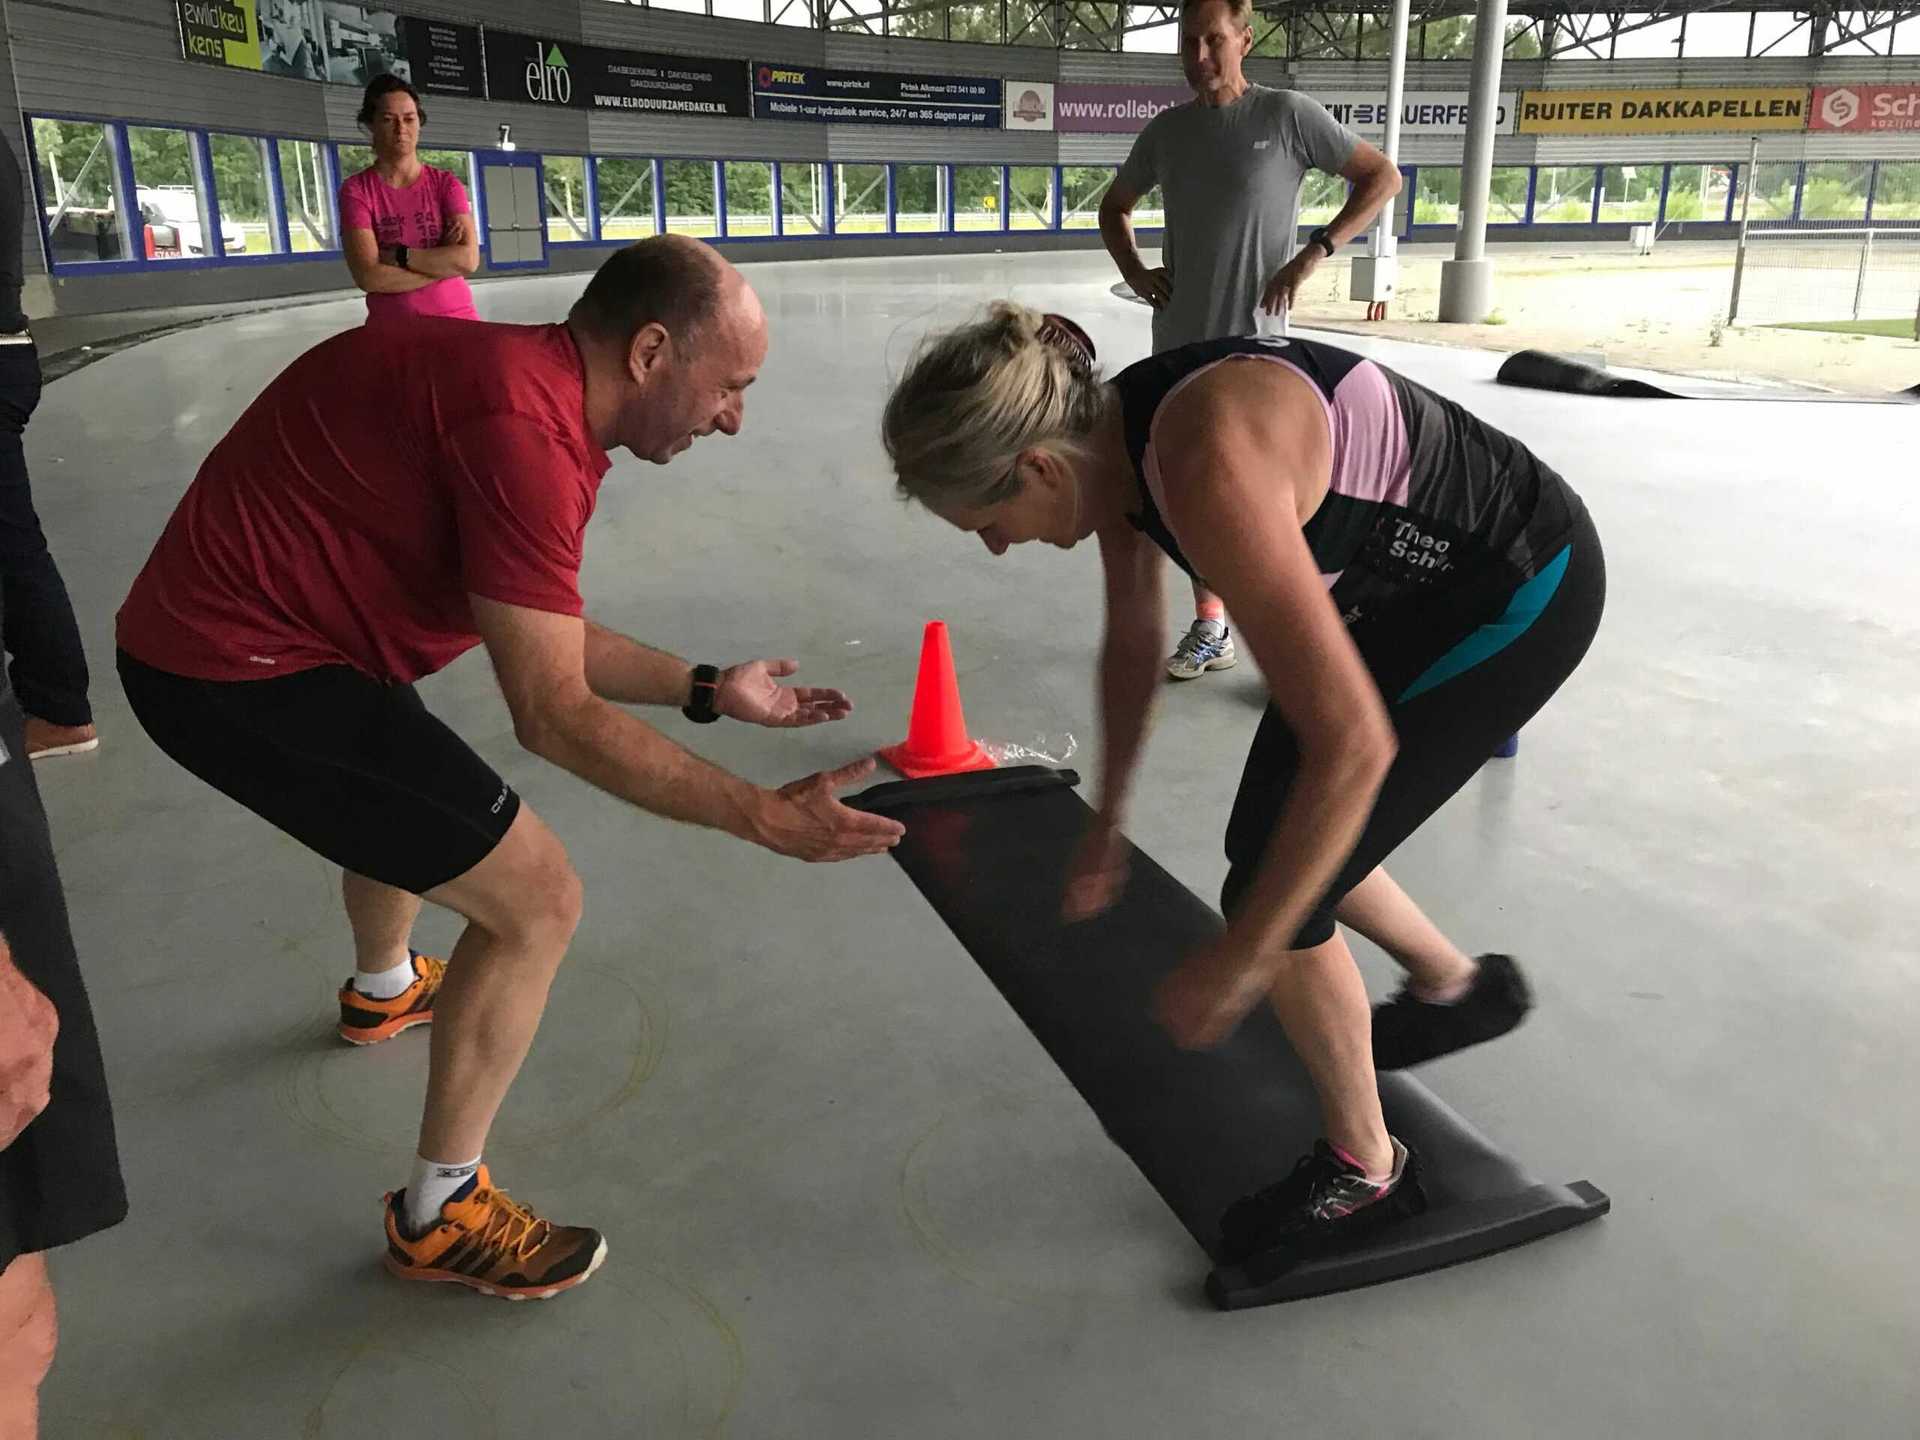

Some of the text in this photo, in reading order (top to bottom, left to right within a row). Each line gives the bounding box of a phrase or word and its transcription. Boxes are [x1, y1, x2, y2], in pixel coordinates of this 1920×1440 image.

[187, 28, 223, 58] kens
[526, 42, 571, 103] elro
[772, 70, 806, 85] PIRTEK
[594, 95, 728, 113] WWW.ELRODUURZAMEDAKEN.NL
[1058, 100, 1176, 119] www.rolleb
[1524, 99, 1802, 121] RUITER DAKKAPELLEN
[890, 108, 907, 118] 24/7
[908, 111, 918, 119] en
[919, 110, 934, 119] 365
[934, 110, 957, 121] dagen
[958, 112, 971, 122] per
[971, 112, 986, 122] jaar
[500, 124, 511, 144] 7
[1395, 517, 1451, 553] Theo
